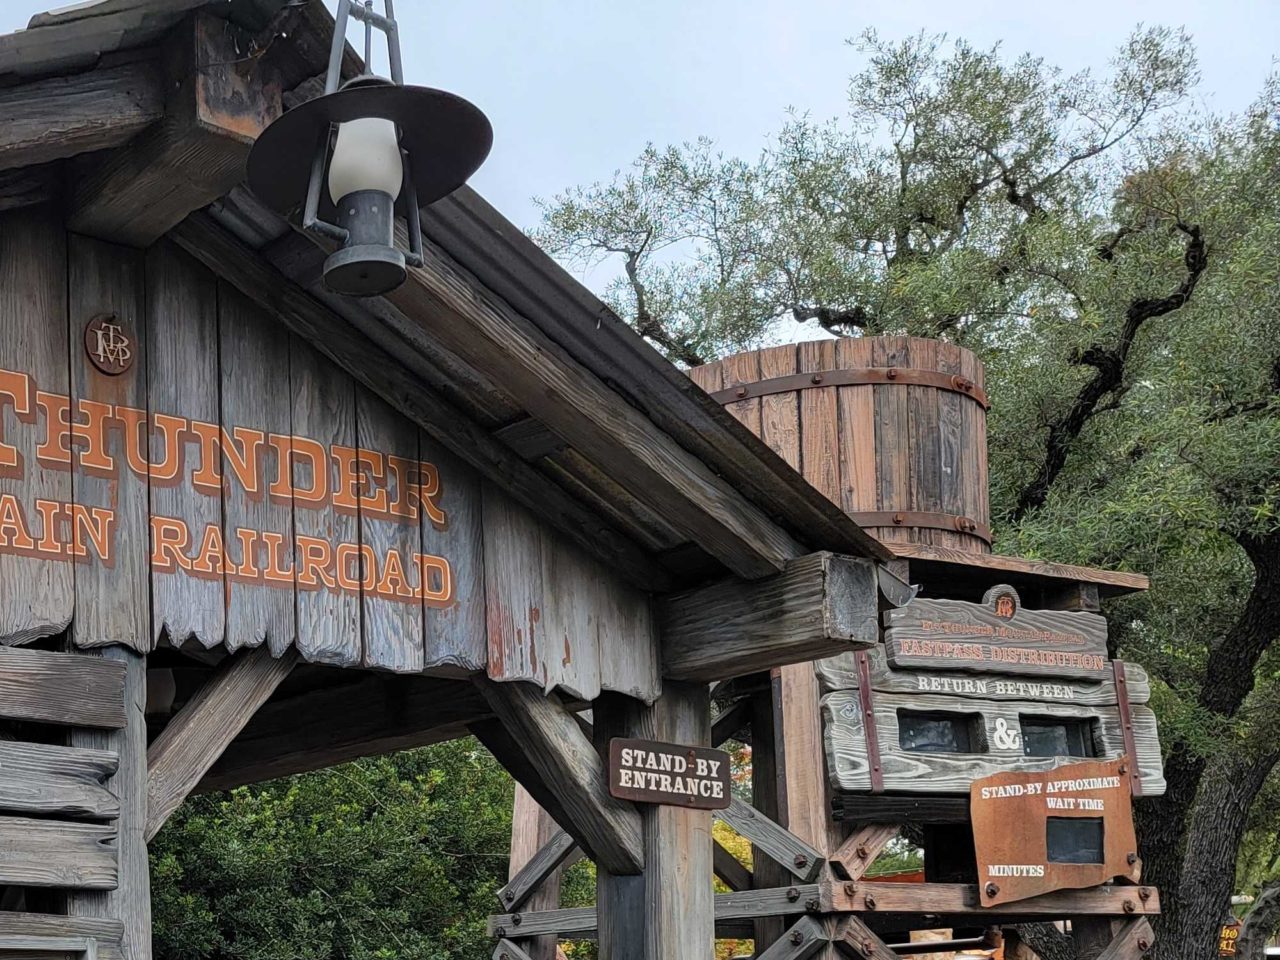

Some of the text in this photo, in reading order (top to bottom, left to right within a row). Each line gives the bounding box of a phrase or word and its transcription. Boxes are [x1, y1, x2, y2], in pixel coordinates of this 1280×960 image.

[150, 513, 454, 602] RAILROAD
[900, 639, 1104, 670] FASTPASS DISTRIBUTION
[918, 676, 1074, 699] RETURN BETWEEN
[994, 718, 1019, 750] &
[619, 769, 723, 798] ENTRANCE
[982, 776, 1120, 799] STAND-BY APPROXIMATE
[1046, 798, 1104, 810] WAIT TIME
[988, 865, 1044, 877] MINUTES
